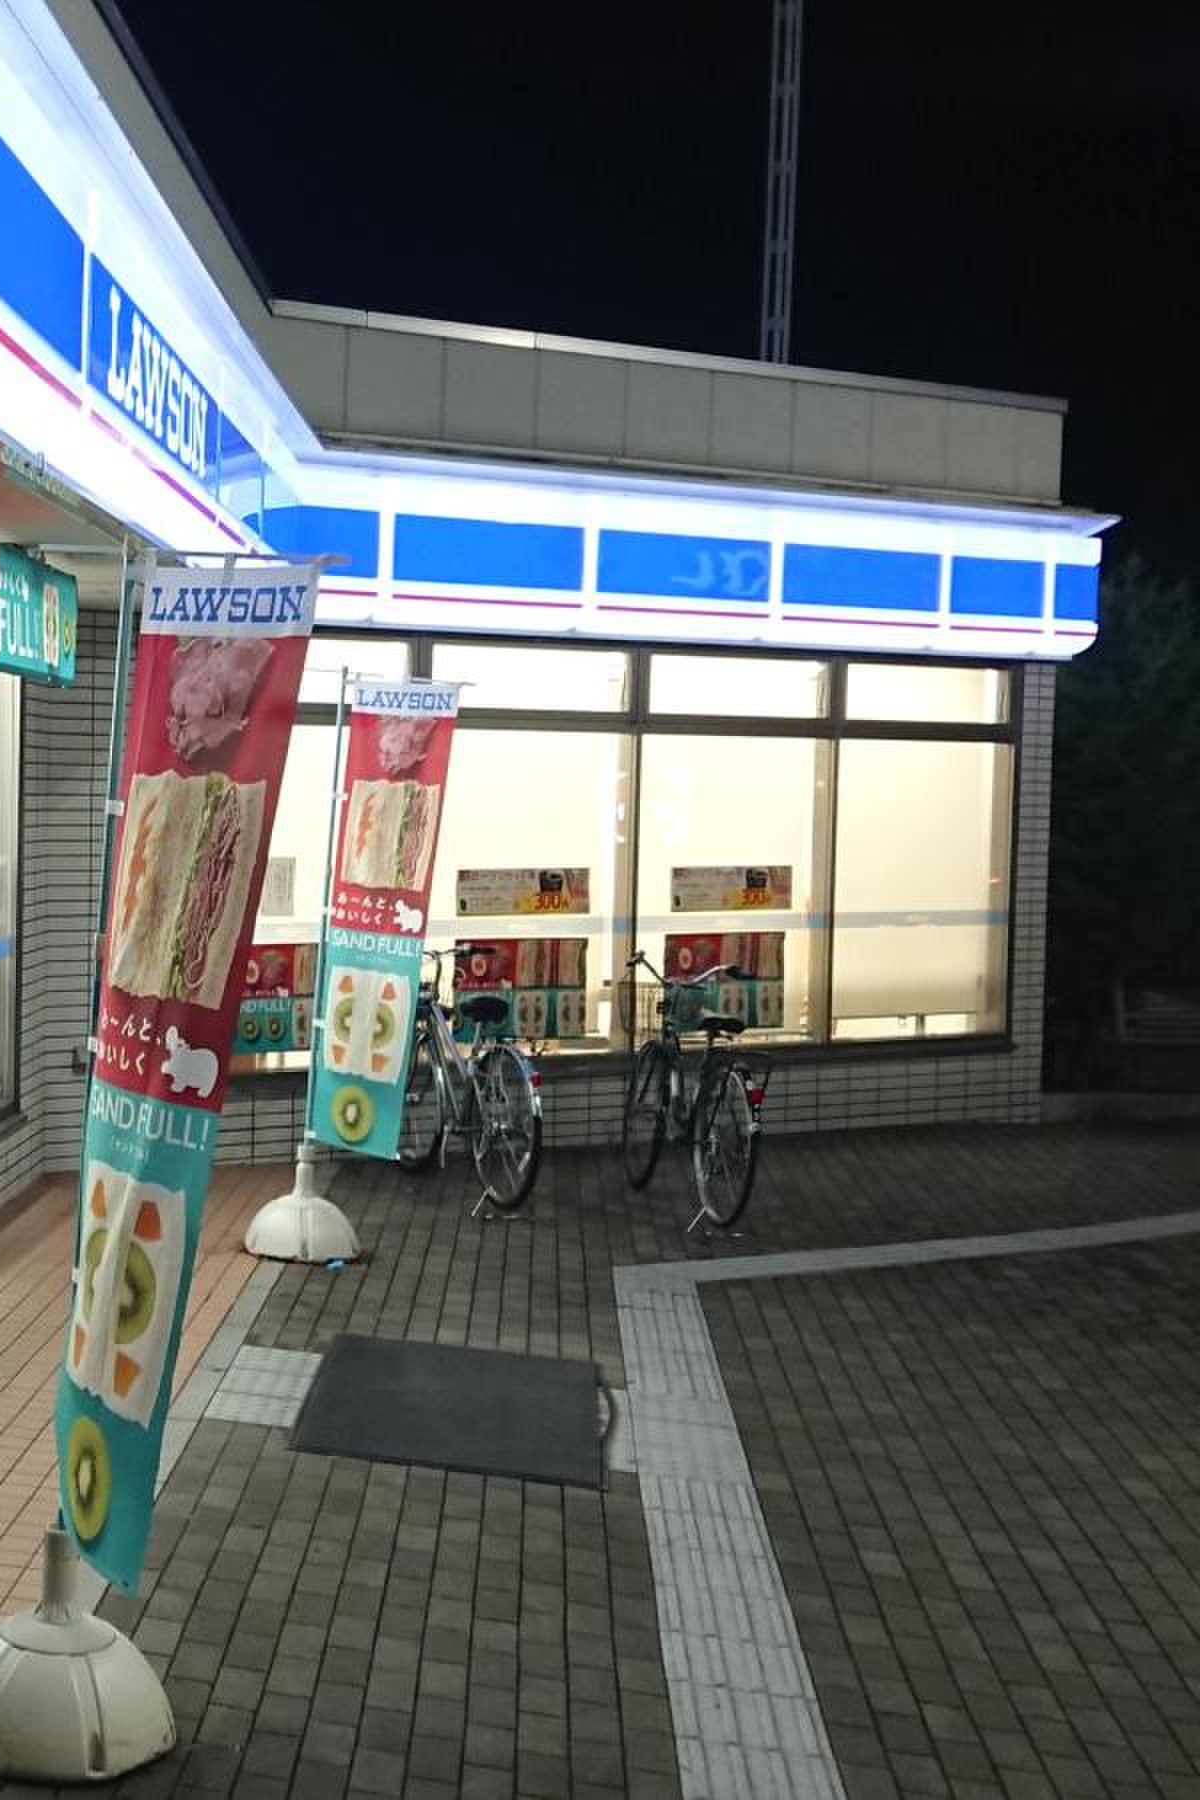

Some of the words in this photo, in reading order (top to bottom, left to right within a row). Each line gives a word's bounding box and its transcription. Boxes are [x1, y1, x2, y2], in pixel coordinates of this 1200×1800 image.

[106, 284, 210, 480] LAWSON
[148, 584, 308, 624] LAWSON
[357, 688, 453, 711] LAWSON
[334, 929, 376, 952] SAND
[136, 1102, 209, 1151] FULL!
